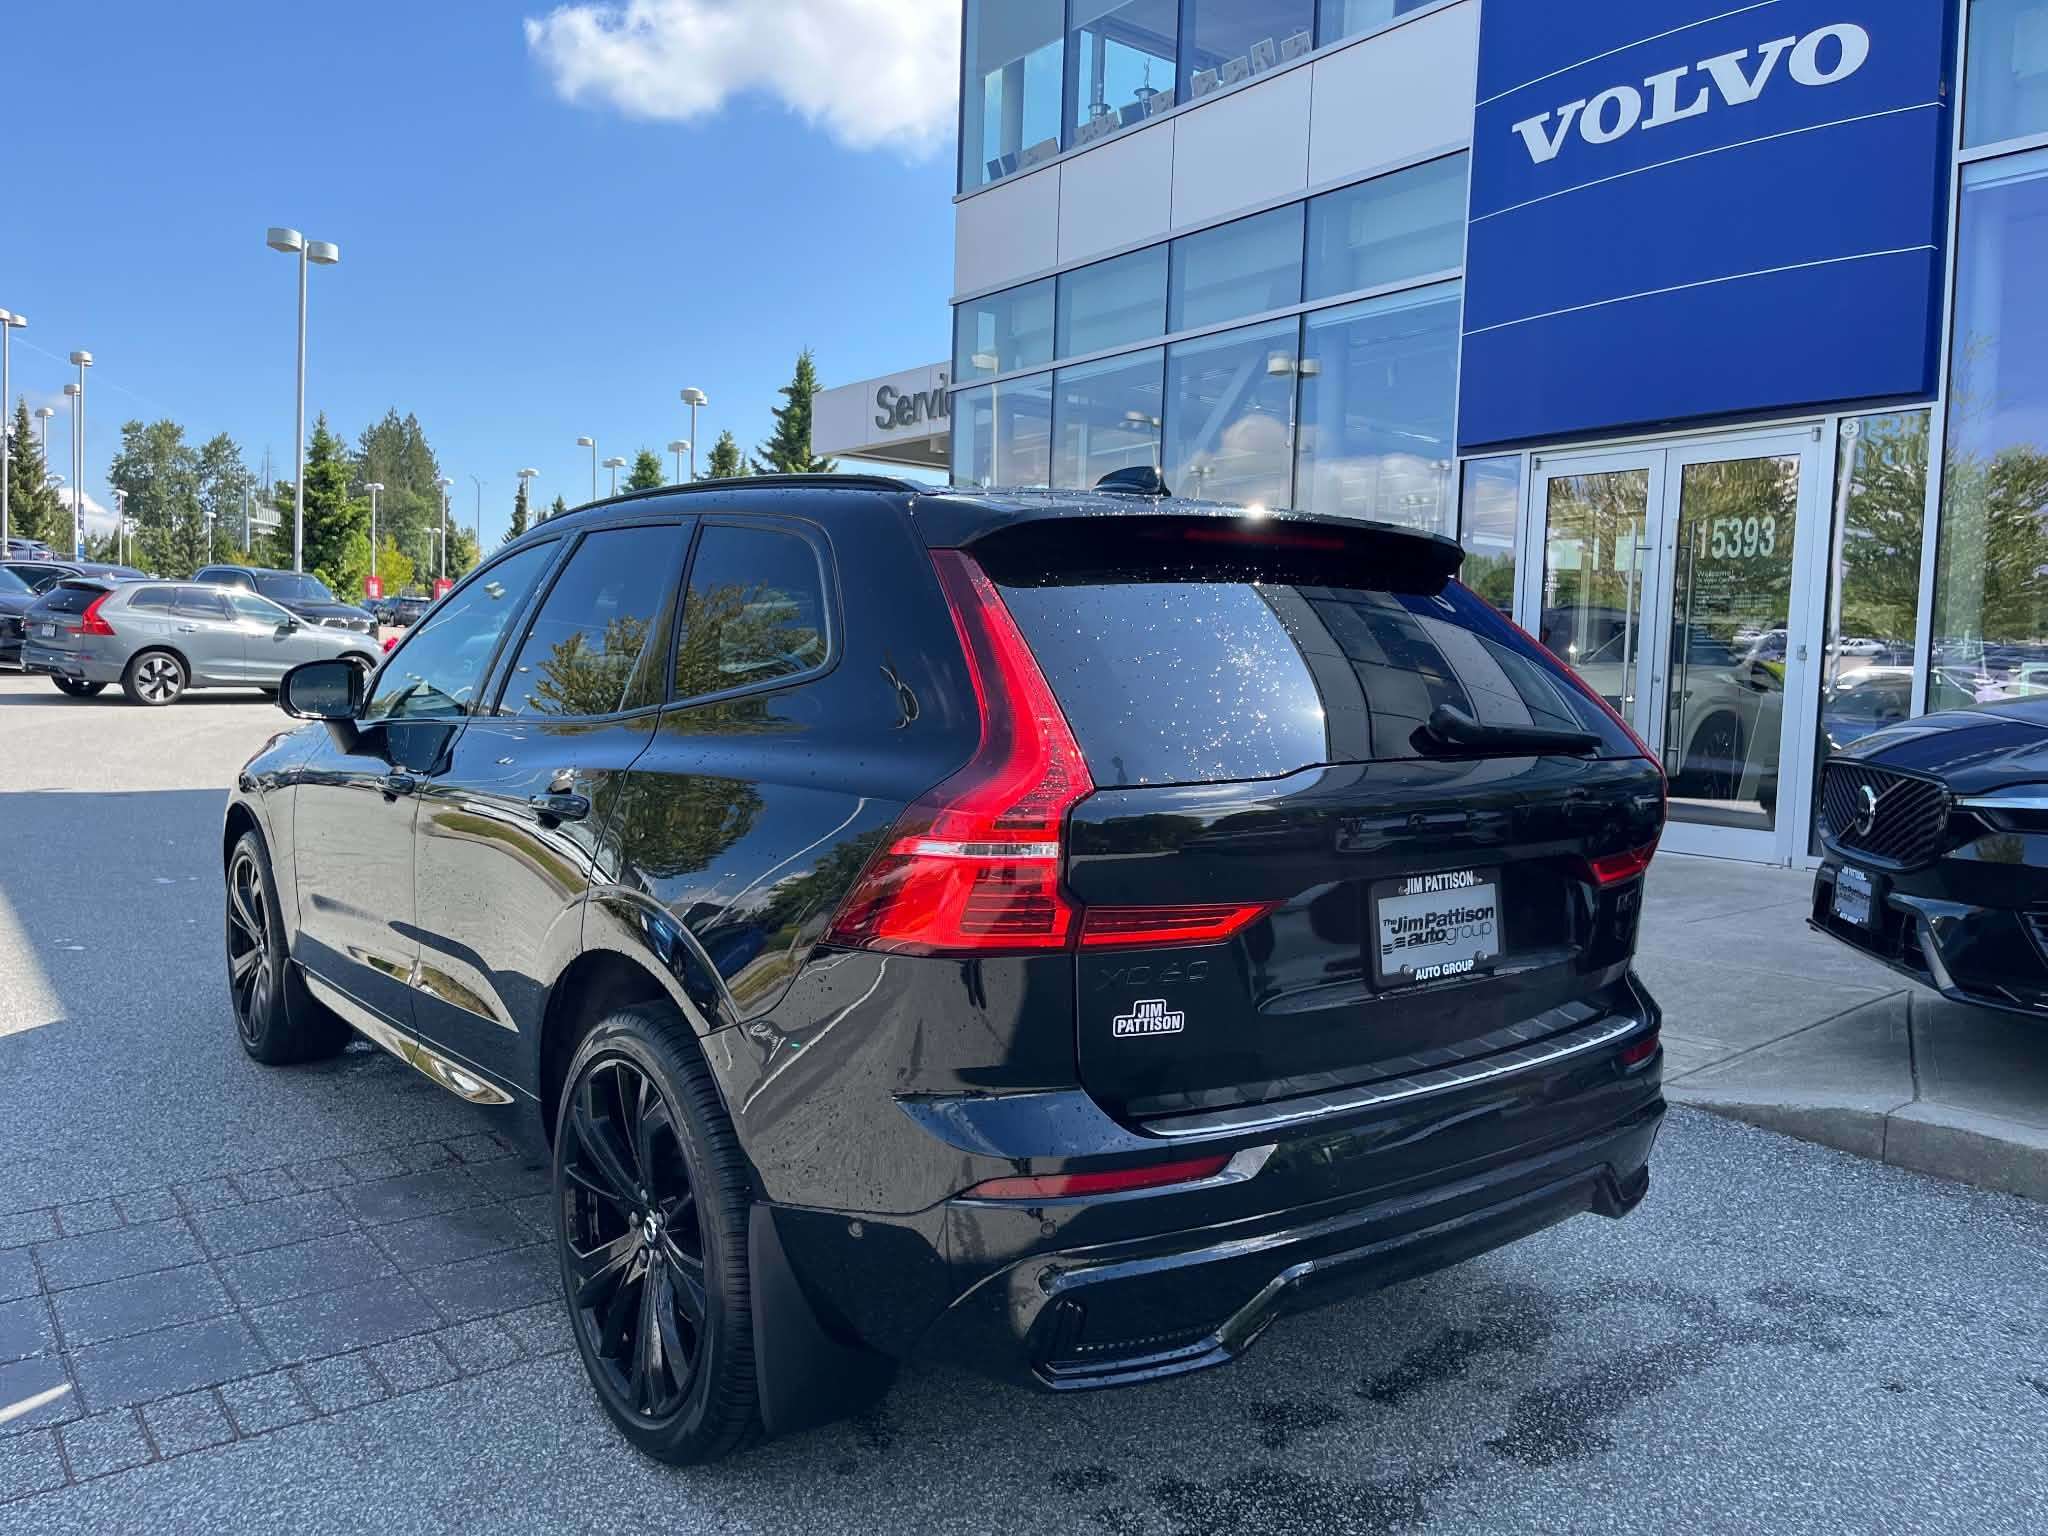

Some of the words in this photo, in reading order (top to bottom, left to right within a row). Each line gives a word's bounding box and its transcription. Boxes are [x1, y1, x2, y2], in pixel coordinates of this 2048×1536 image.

[1511, 23, 1870, 164] VOLVO
[1697, 516, 1776, 560] 15393
[1405, 877, 1423, 895] JIM
[1425, 871, 1474, 892] PATTISON
[1415, 966, 1441, 981] AUTO
[1442, 960, 1475, 976] GROUP
[1137, 1003, 1163, 1019] JIM
[1117, 1015, 1181, 1034] PATTISON
